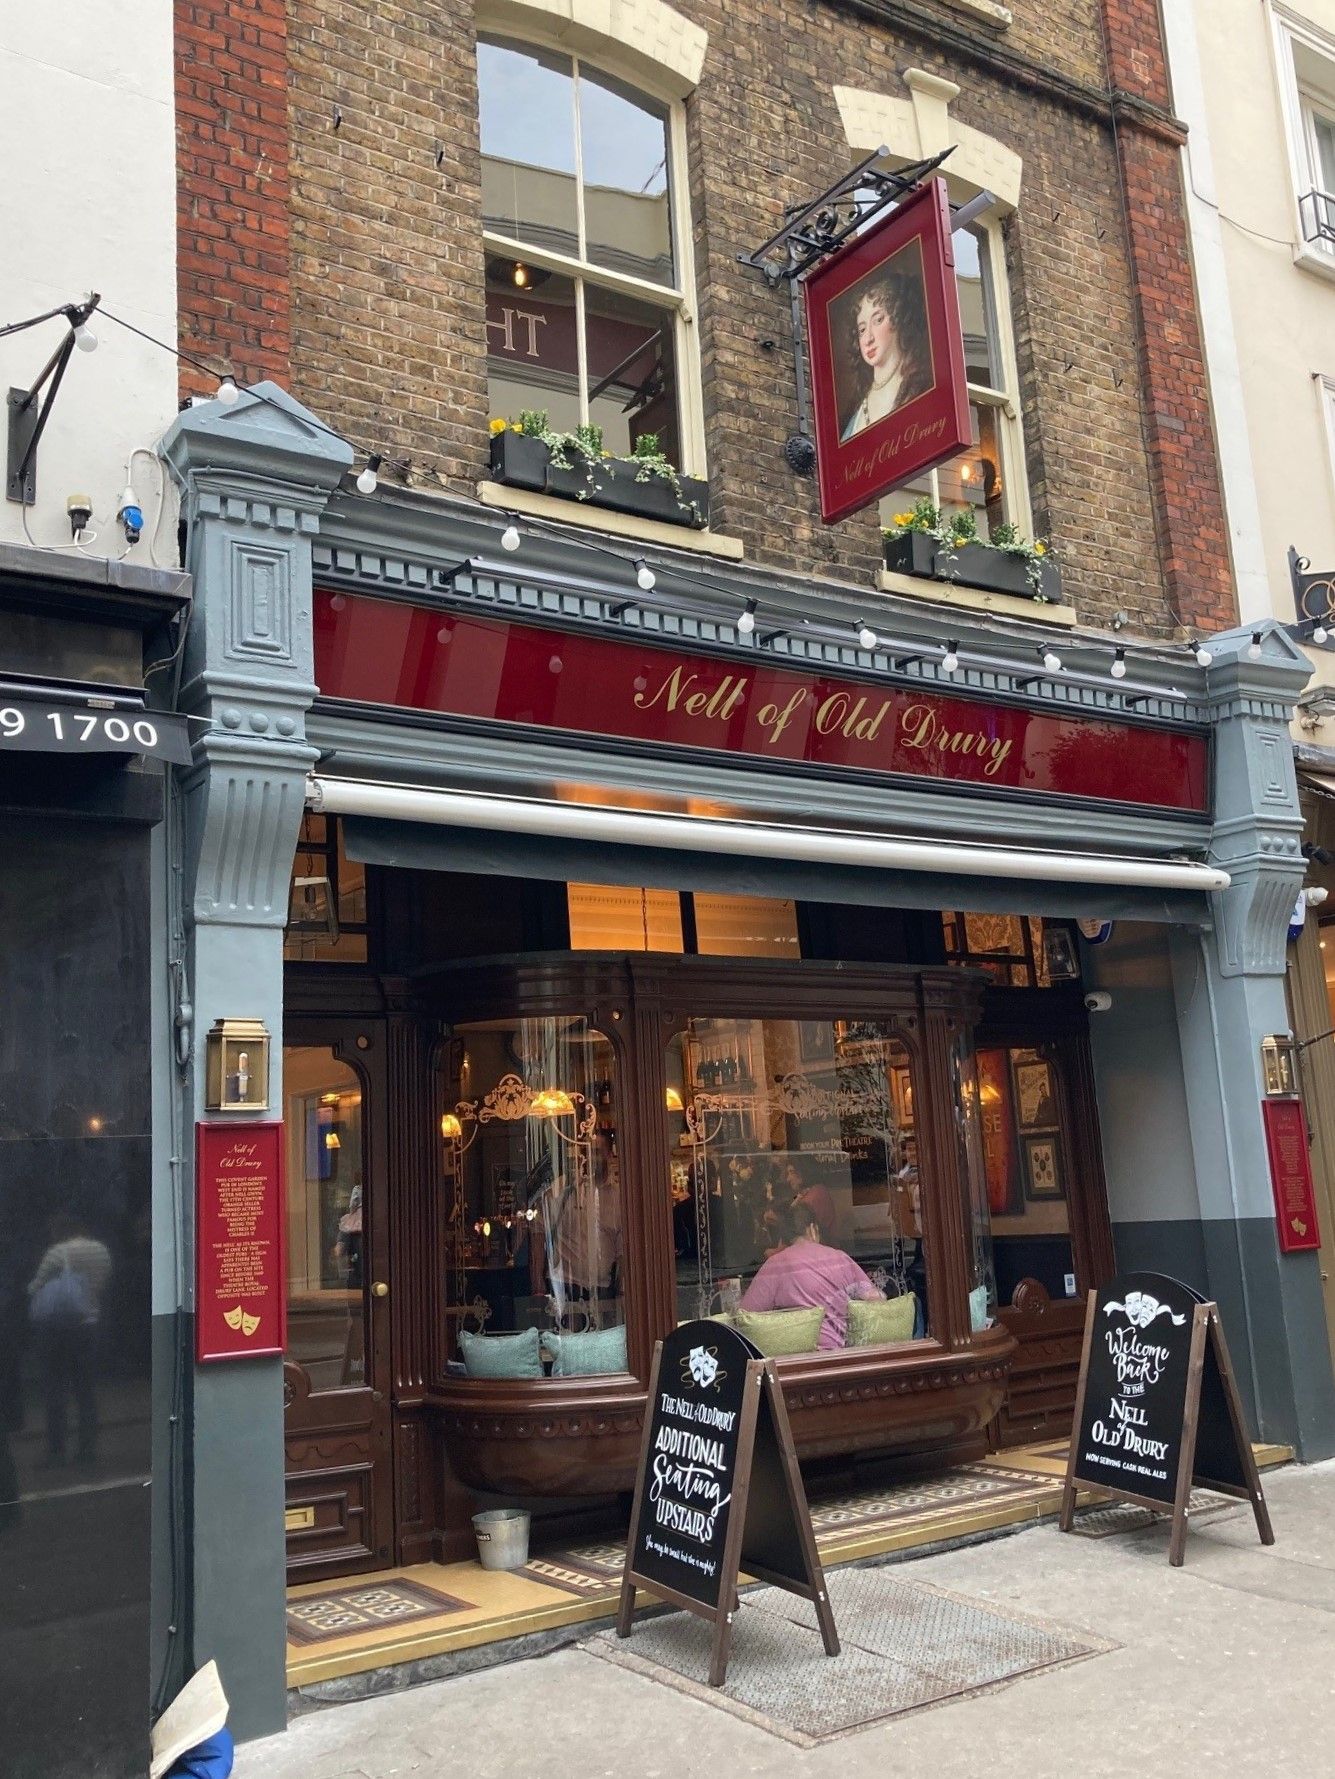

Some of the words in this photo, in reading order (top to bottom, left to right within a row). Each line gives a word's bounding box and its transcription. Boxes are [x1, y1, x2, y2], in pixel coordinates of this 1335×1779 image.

[835, 457, 864, 490] Nell
[864, 448, 880, 478] of
[878, 434, 900, 464] Old
[903, 416, 947, 450] Drury
[47, 713, 158, 747] 1700
[634, 665, 747, 720] Nell
[756, 688, 807, 743] of
[815, 691, 890, 741] Old
[900, 704, 1013, 776] Drury
[220, 1158, 235, 1168] Old
[235, 1157, 262, 1169] Drury
[227, 1144, 248, 1154] Nell
[247, 1144, 257, 1156] of
[1105, 1326, 1170, 1372] Welcome
[1113, 1352, 1159, 1384] Back
[1122, 1386, 1132, 1394] TO
[1132, 1383, 1145, 1394] THE
[661, 1393, 677, 1415] THE
[676, 1397, 695, 1421] NELL
[698, 1403, 713, 1425] OLD
[711, 1406, 736, 1432] DRURY
[1108, 1397, 1149, 1427] NELL
[1116, 1420, 1128, 1437] of
[655, 1425, 727, 1471] ADDITIONAL
[1091, 1420, 1121, 1447] OLD
[1123, 1427, 1169, 1460] DRURY
[1085, 1452, 1100, 1463] NOW
[1100, 1456, 1121, 1469] SERVING
[1122, 1461, 1137, 1473] CASK
[1137, 1465, 1152, 1477] REAL
[1152, 1469, 1167, 1480] ALES
[650, 1454, 732, 1517] Seating
[656, 1497, 715, 1543] UPSTAIRS
